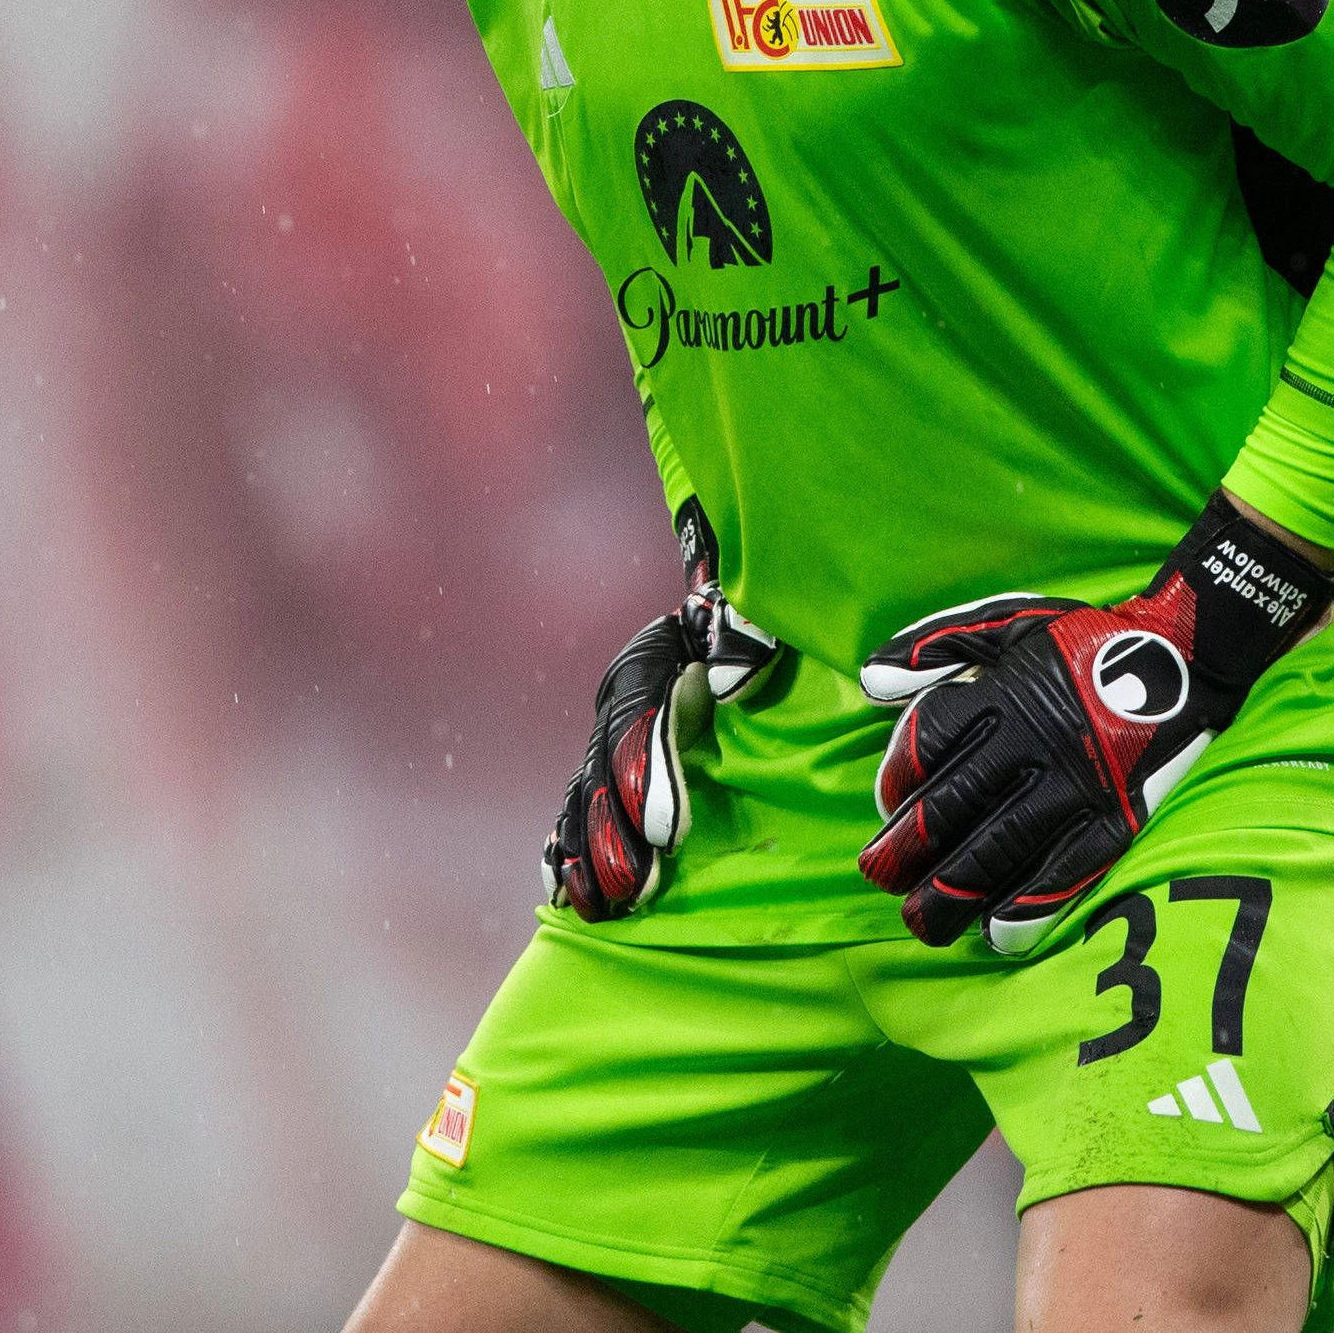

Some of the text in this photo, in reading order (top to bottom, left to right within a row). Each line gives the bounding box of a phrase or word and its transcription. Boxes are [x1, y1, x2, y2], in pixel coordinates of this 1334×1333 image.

[798, 8, 875, 46] UNION
[617, 265, 901, 369] Paramount+
[1201, 555, 1296, 627] Alexander
[1216, 539, 1308, 610] Schwolow
[1077, 874, 1273, 1067] 37
